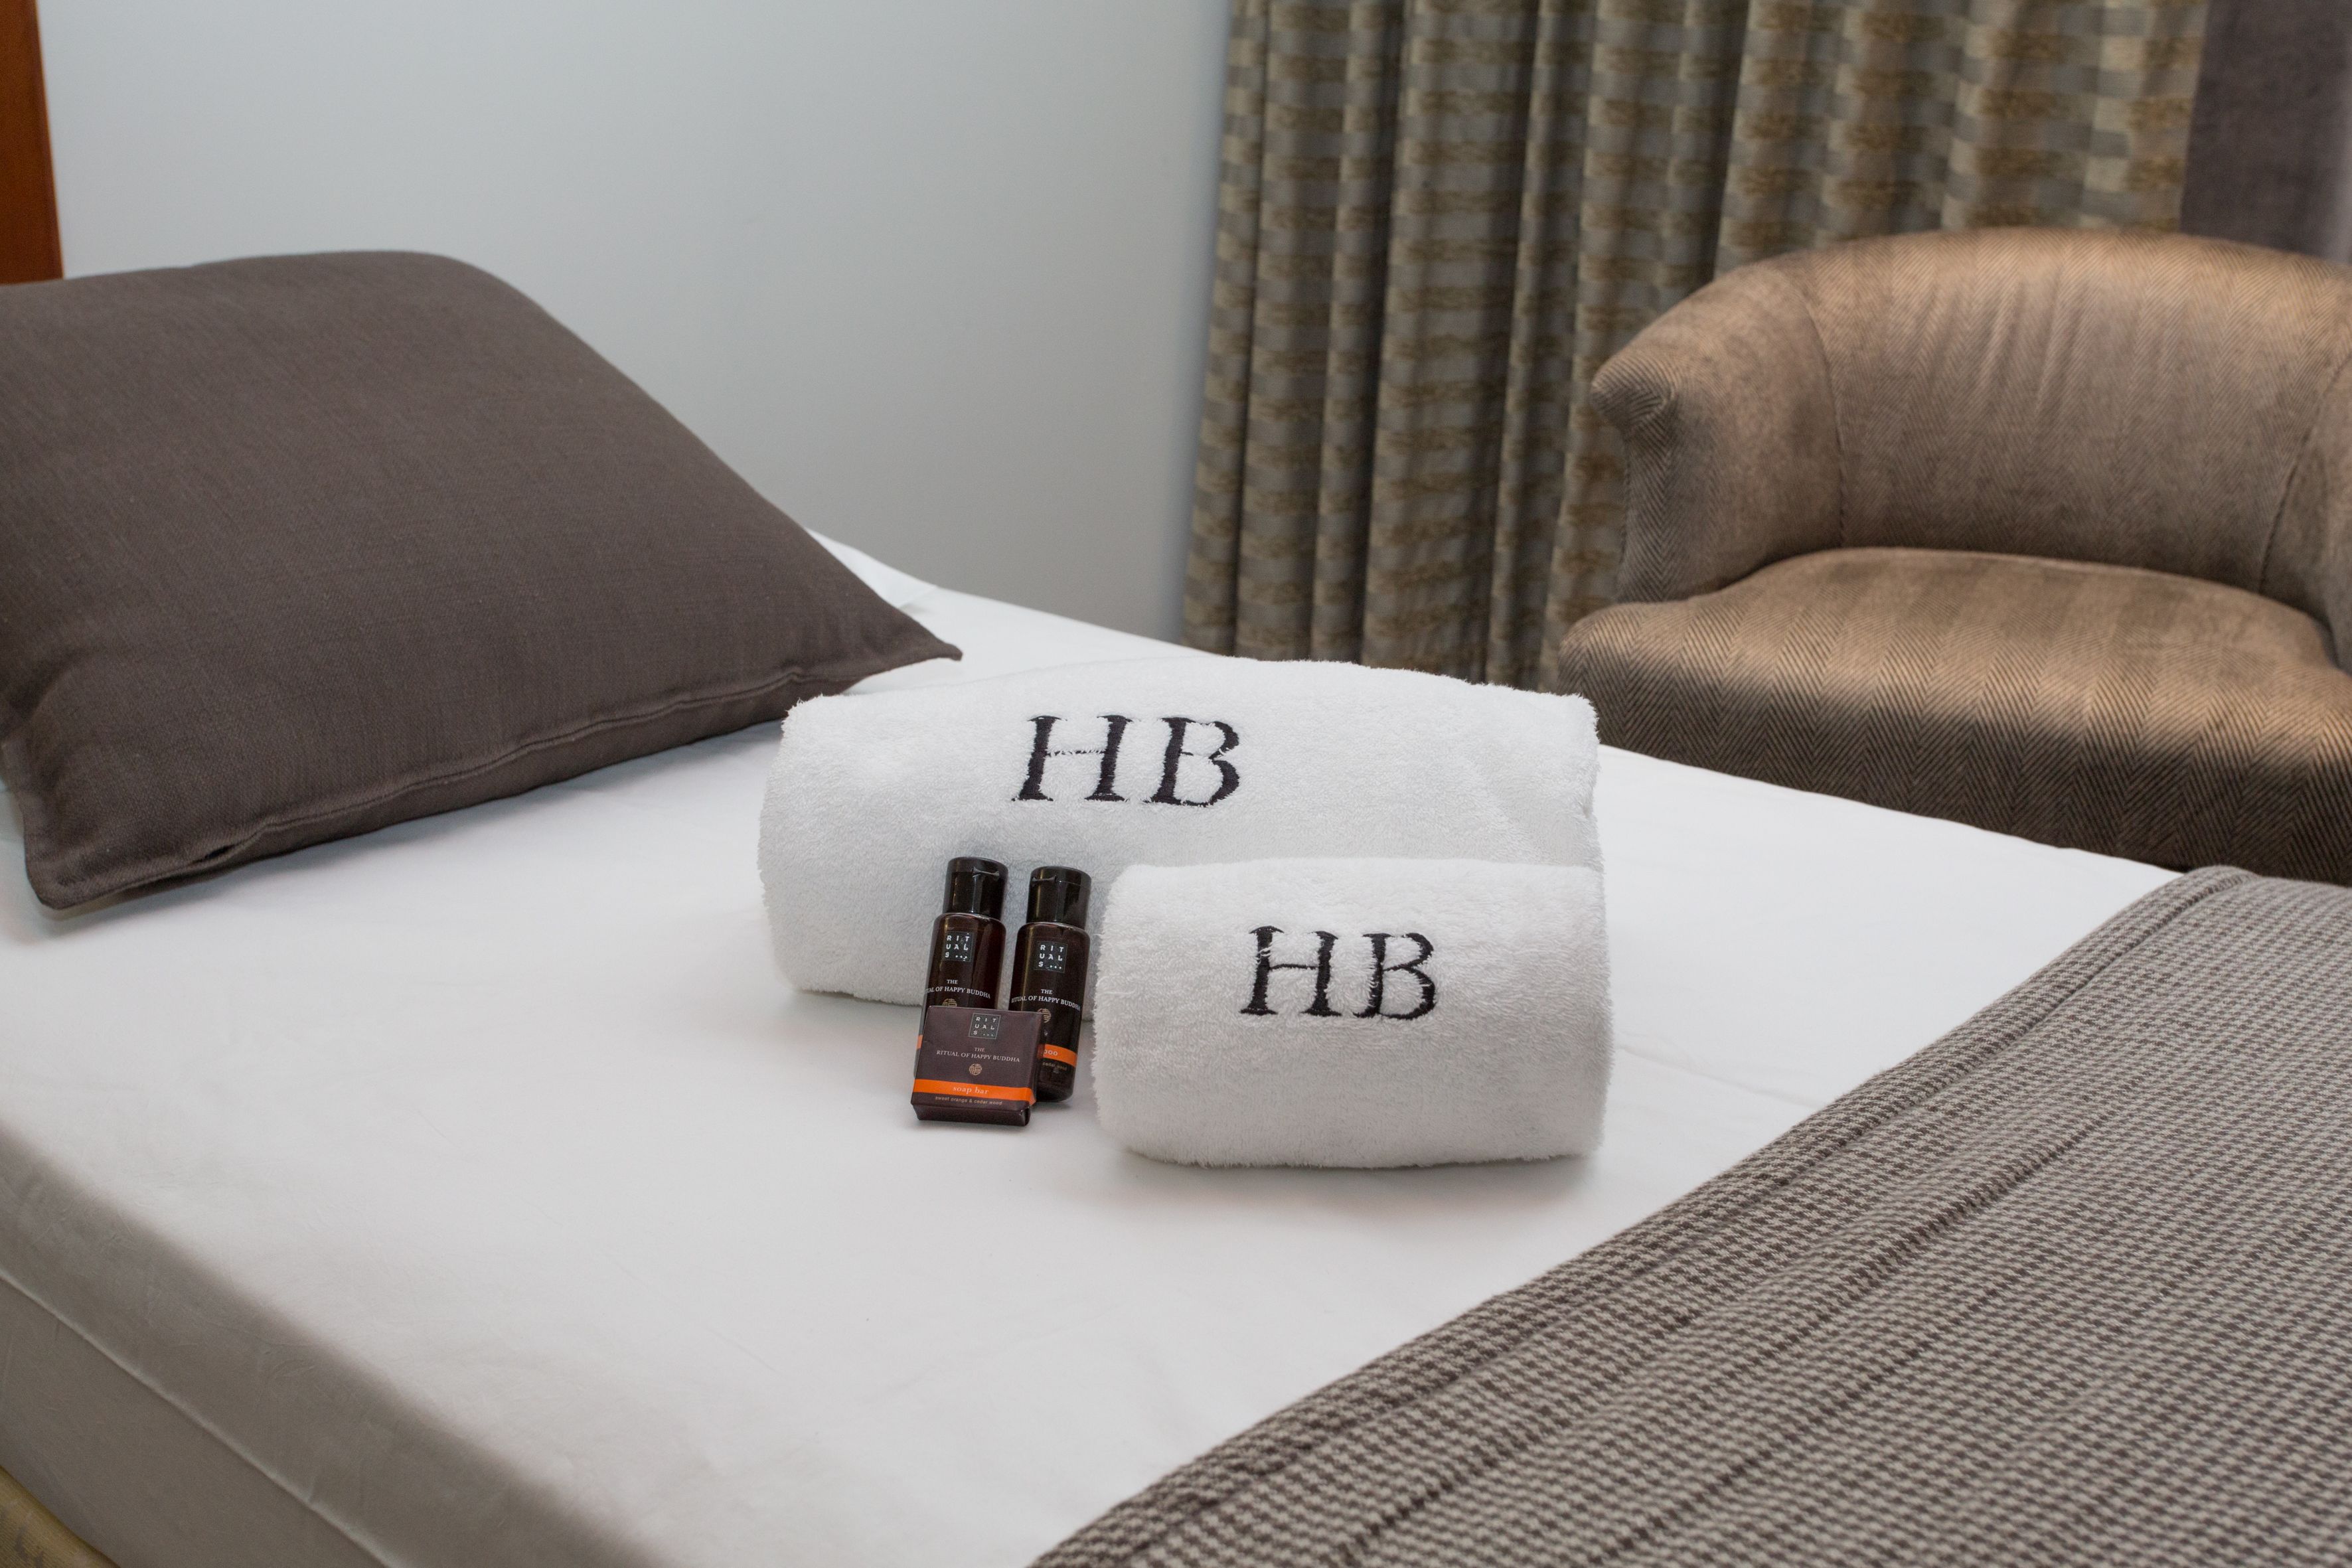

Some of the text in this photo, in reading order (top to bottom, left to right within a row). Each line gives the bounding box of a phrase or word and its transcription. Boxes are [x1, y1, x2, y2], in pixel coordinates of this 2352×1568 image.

[1010, 715, 1240, 807] HB
[967, 988, 991, 999] BUDDHA
[1239, 925, 1437, 1020] HB
[1061, 999, 1081, 1012] BUDDHA
